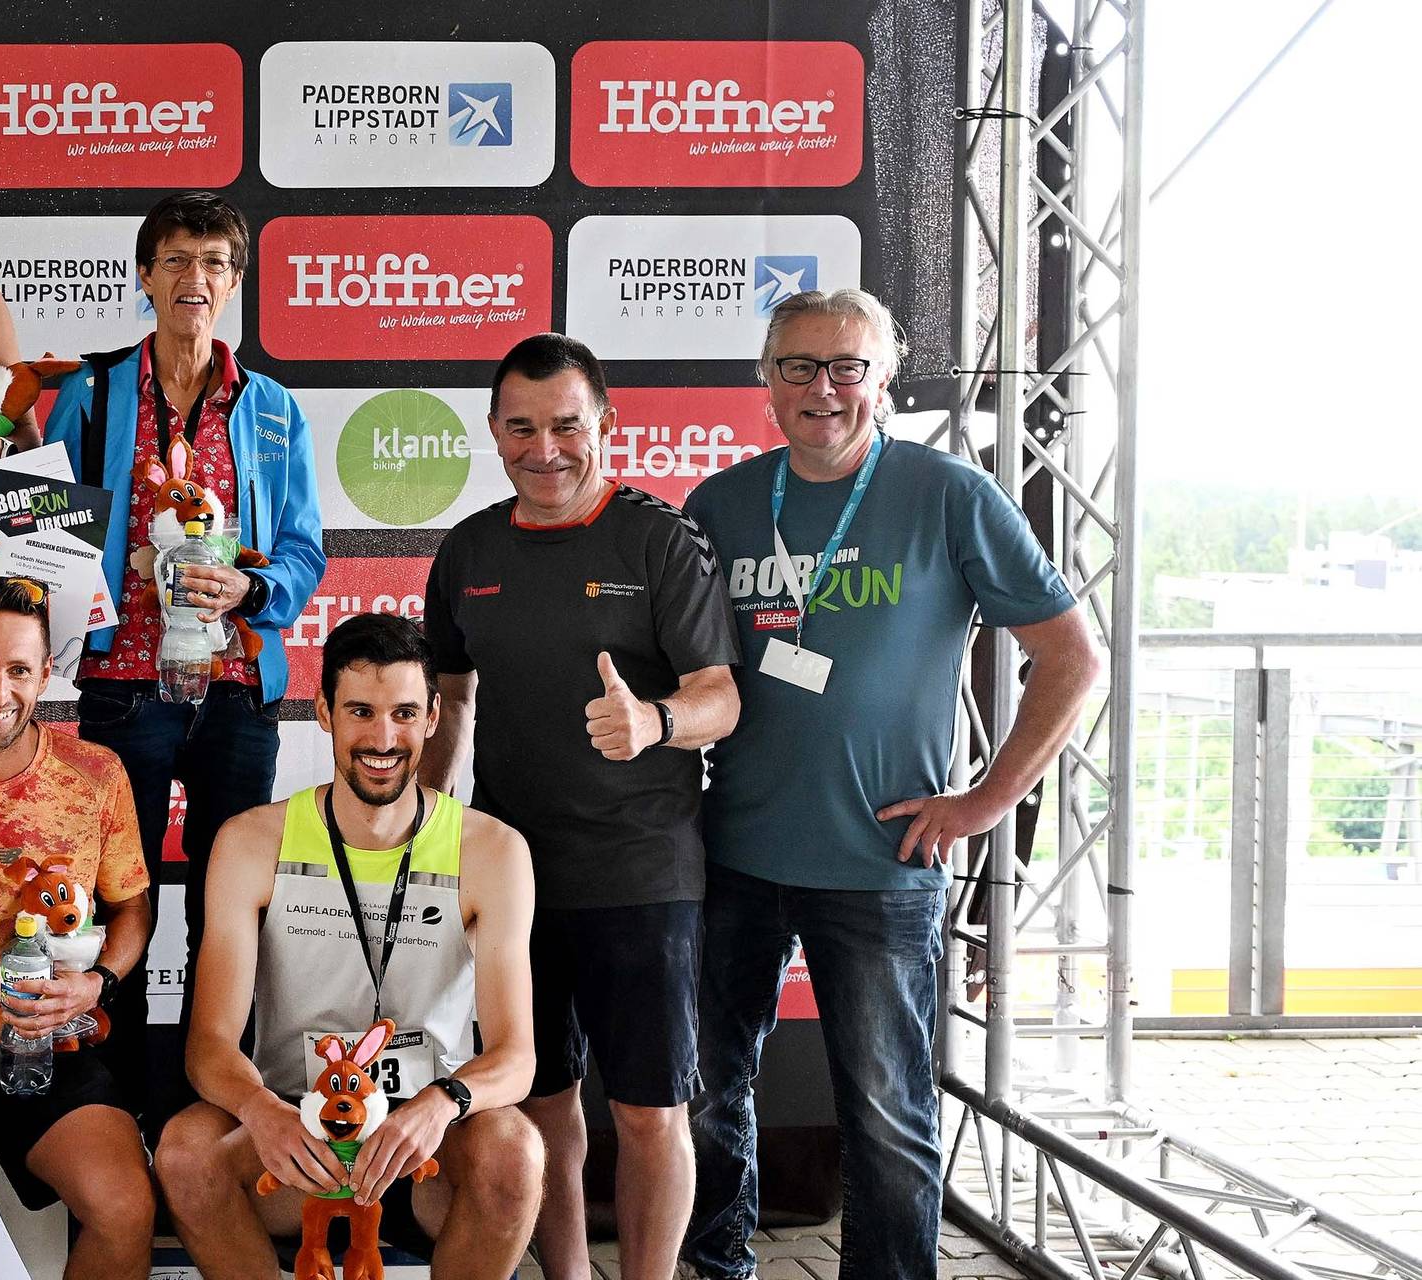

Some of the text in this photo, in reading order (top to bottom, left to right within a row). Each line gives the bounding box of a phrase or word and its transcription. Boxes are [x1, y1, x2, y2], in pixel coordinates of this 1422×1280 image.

[303, 85, 439, 104] PADERBORN
[599, 79, 834, 133] Höffner
[314, 110, 439, 128] LIPPSTADT
[68, 136, 217, 157] Wo Wohnen wenig kostet!
[314, 133, 437, 145] AIRPORT
[690, 135, 837, 156] Wo Wohnen wenig kostet!
[609, 259, 746, 277] PADERBORN
[288, 253, 524, 307] Höffner
[1, 283, 126, 302] LIPPSTADT
[620, 283, 745, 300] LIPPSTADT
[21, 307, 124, 319] IRPORT
[379, 308, 526, 330] Wo Wohnen wenig kostet!
[620, 306, 743, 317] AIRPORT
[255, 425, 288, 448] FUSION
[373, 428, 471, 459] klante
[373, 460, 402, 472] biking
[29, 484, 49, 495] BAHN
[30, 489, 69, 516] RUN
[36, 509, 94, 531] URKUNDE
[26, 539, 56, 551] HERZLICHEN
[808, 563, 903, 615] RUN
[286, 904, 353, 918] LAUFLADEN
[287, 925, 326, 937] Detmold
[395, 936, 438, 948] aderborn
